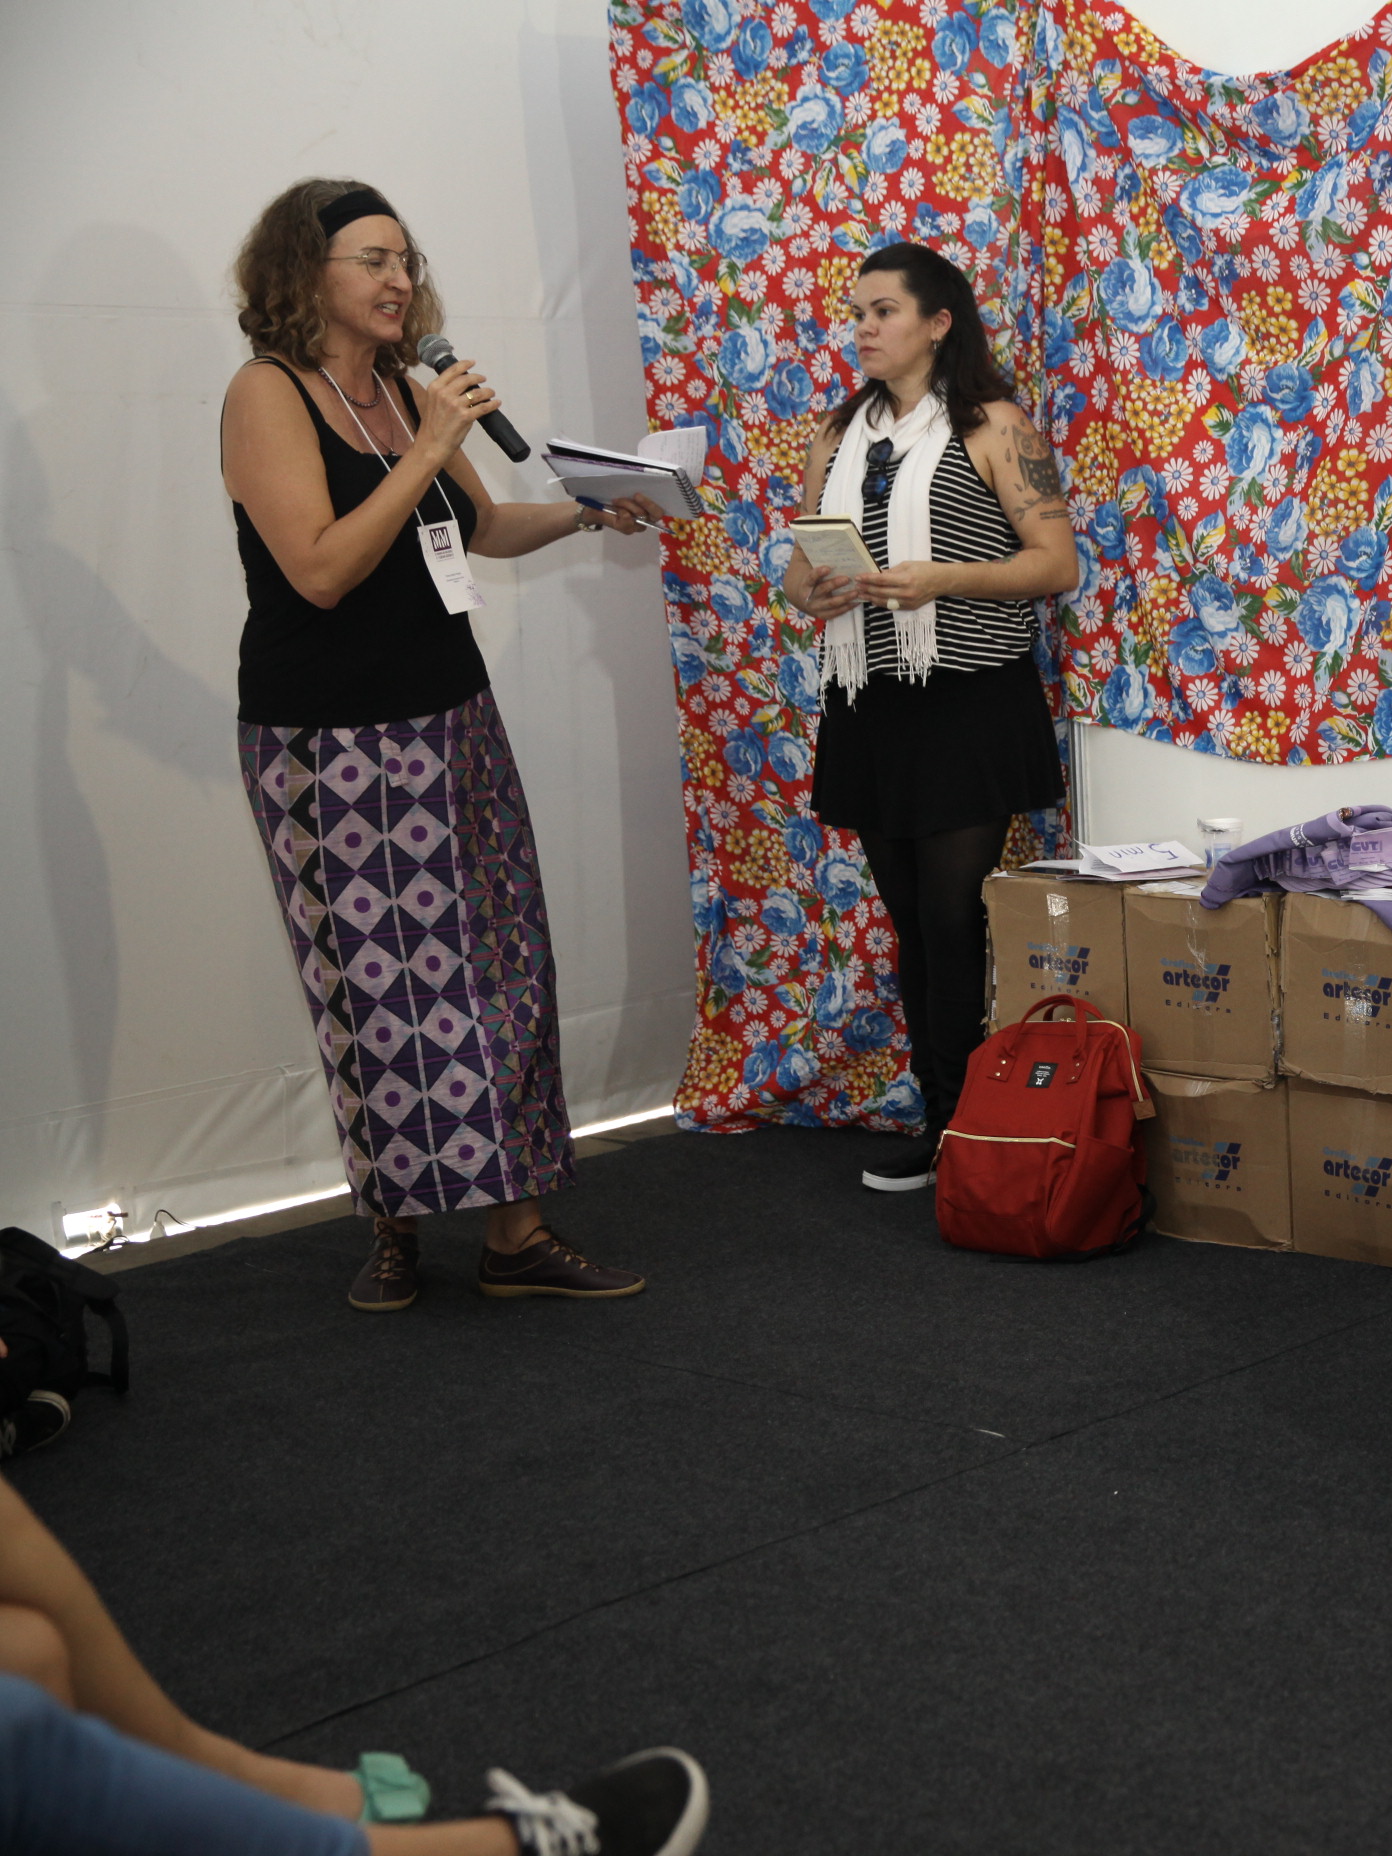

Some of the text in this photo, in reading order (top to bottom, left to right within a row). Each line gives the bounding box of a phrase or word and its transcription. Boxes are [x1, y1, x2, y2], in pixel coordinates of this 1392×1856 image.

[1148, 843, 1179, 860] 5
[1351, 841, 1380, 851] CUT
[1327, 857, 1345, 870] CU
[1029, 953, 1089, 974] artecor
[1163, 969, 1230, 992] artecor
[1323, 981, 1391, 1006] artecor
[1323, 1160, 1391, 1187] artecor
